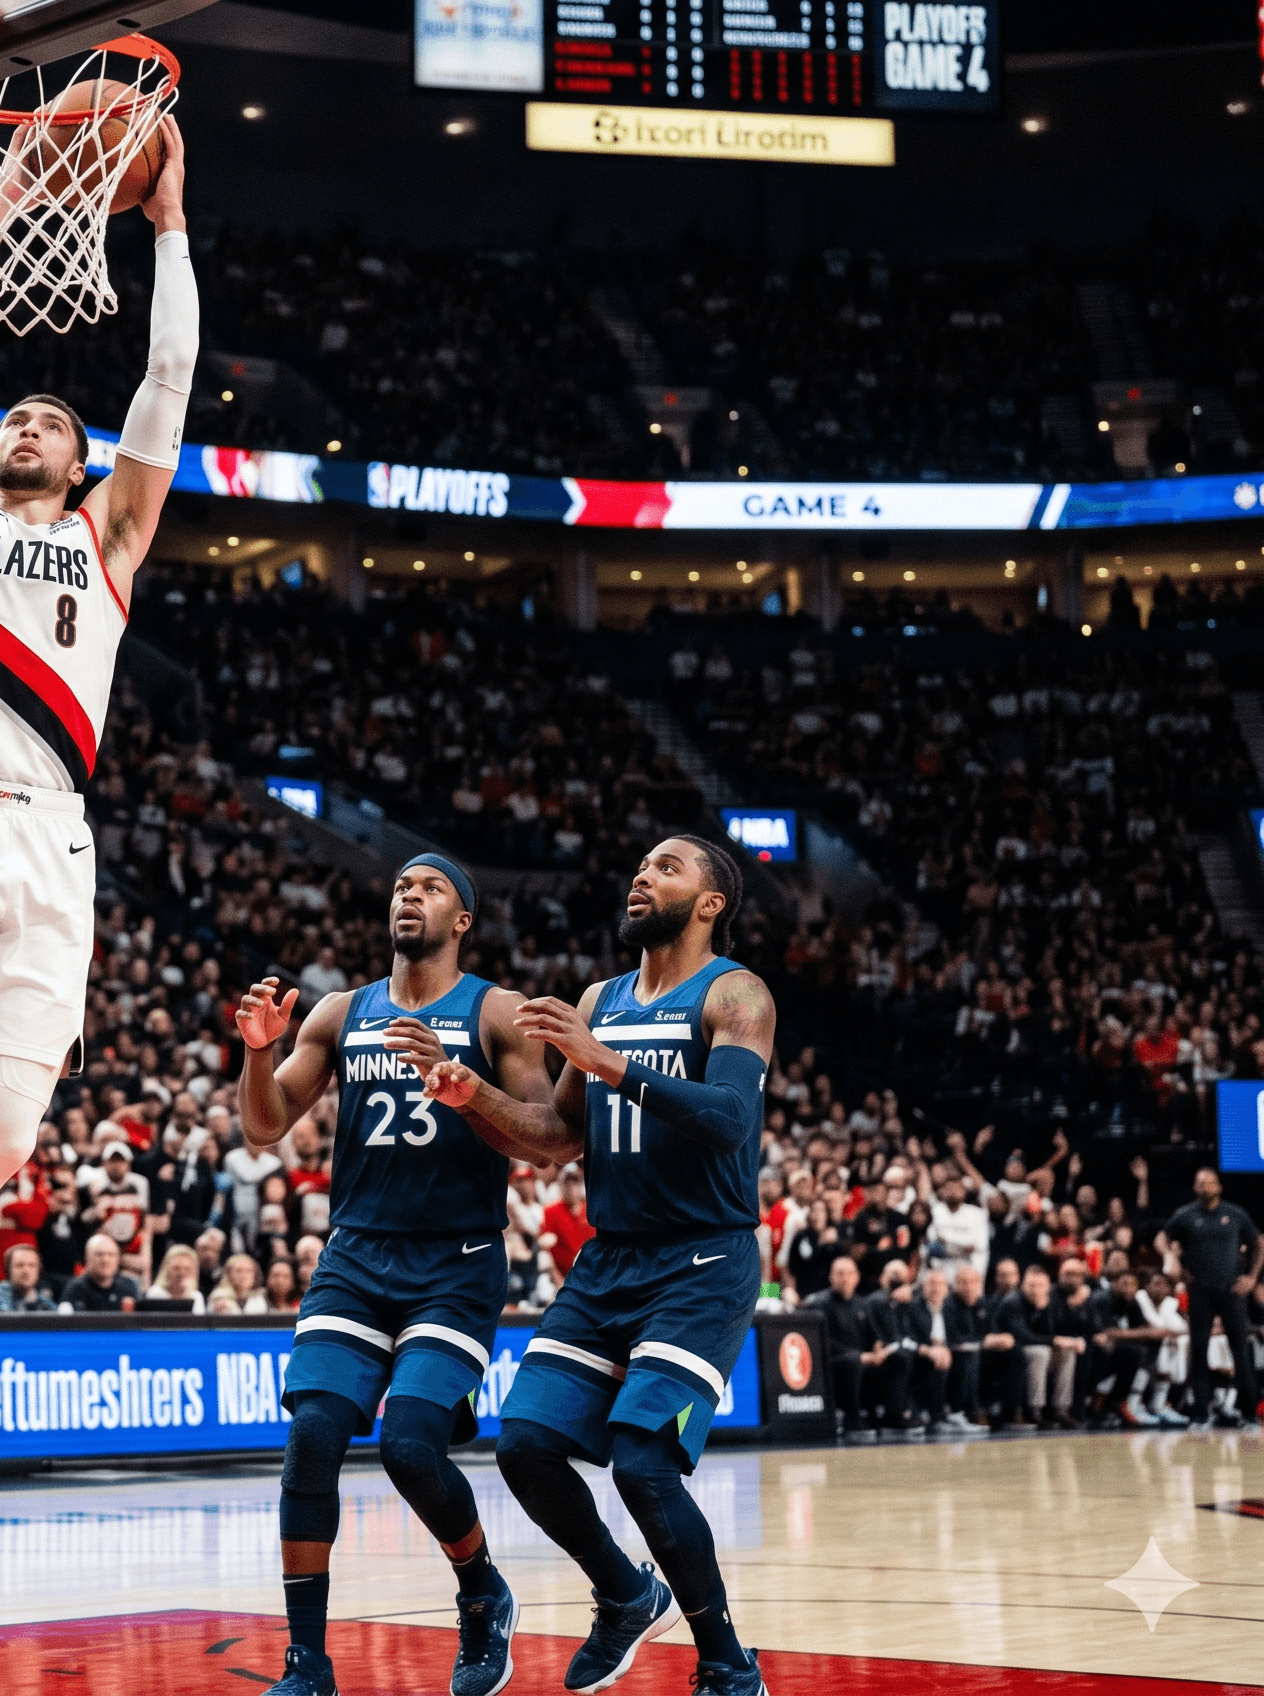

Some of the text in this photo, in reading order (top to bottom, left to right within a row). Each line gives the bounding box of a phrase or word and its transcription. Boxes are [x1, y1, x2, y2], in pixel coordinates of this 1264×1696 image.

[885, 41, 963, 91] GAME
[967, 45, 989, 93] 4
[389, 464, 510, 517] PLAYOFFS
[743, 495, 882, 517] GAME 4
[55, 593, 78, 649] 8
[365, 1091, 437, 1146] 23
[607, 1094, 642, 1153] 11
[216, 1351, 279, 1426] NBA
